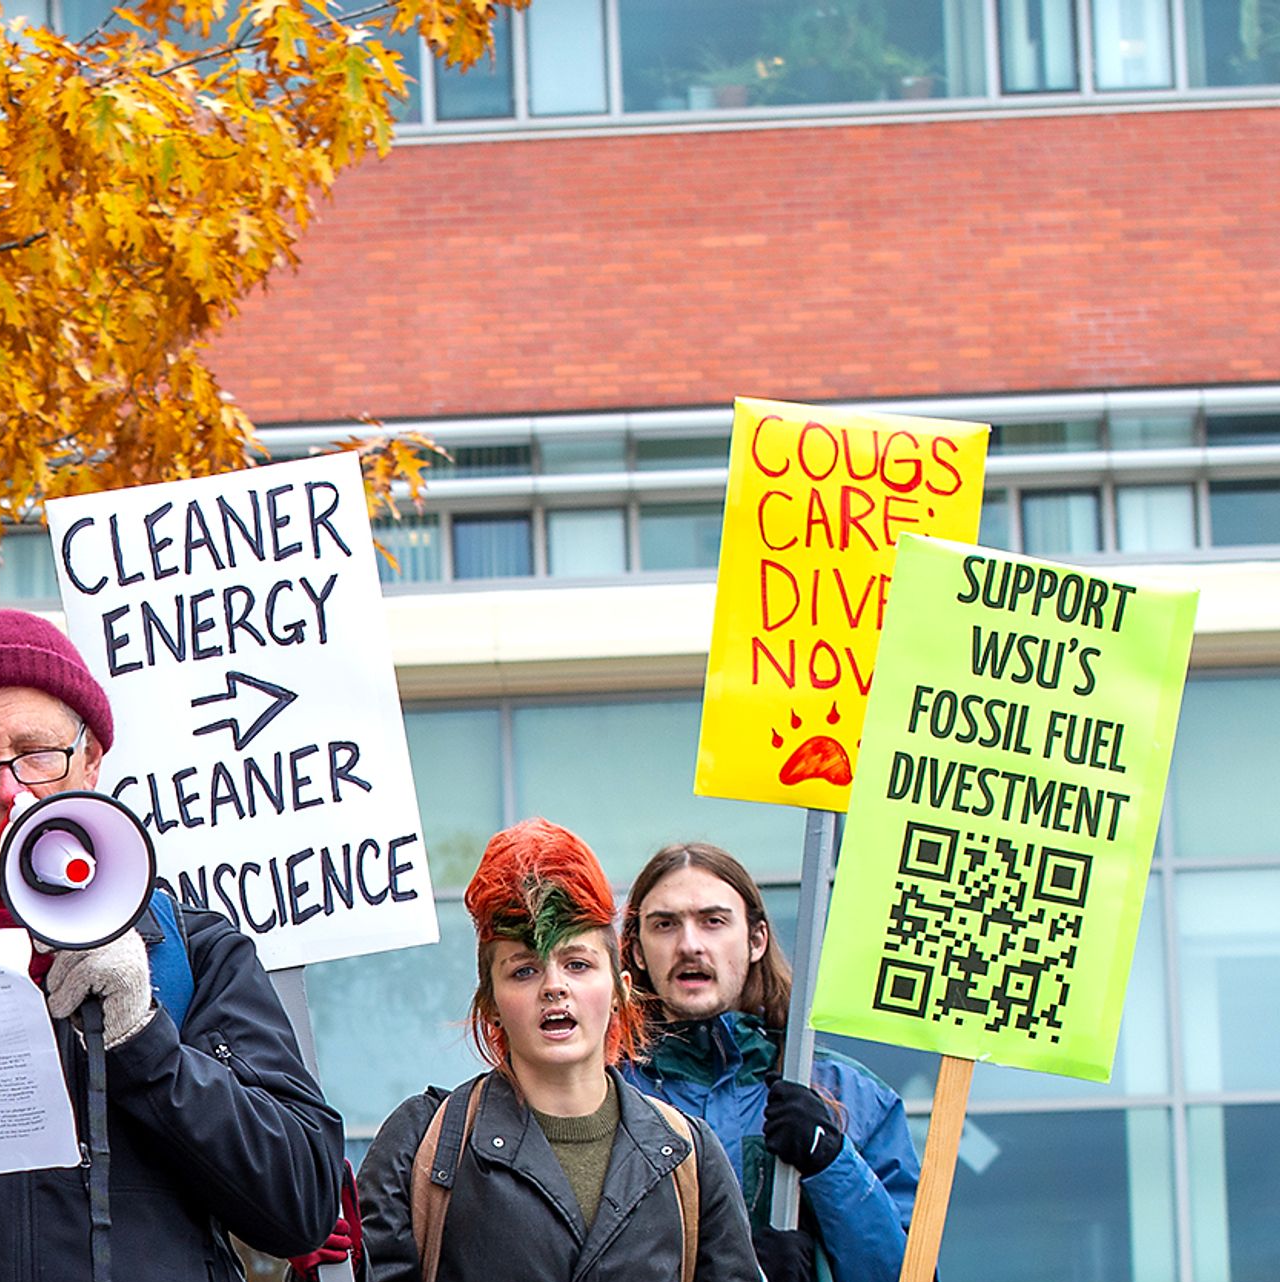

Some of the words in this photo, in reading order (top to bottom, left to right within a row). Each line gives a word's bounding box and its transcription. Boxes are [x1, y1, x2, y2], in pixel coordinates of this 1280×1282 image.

[752, 414, 963, 496] COUGS
[61, 481, 352, 595] CLEANER
[101, 573, 338, 677] ENERGY
[761, 559, 891, 632] DIV
[957, 556, 1136, 633] SUPPORT
[971, 625, 1102, 695] WSU'S
[908, 685, 1032, 756] FOSSIL
[1044, 713, 1127, 774] FUEL
[887, 751, 1130, 842] DIVESTMENT
[154, 833, 418, 934] NSCIENCE
